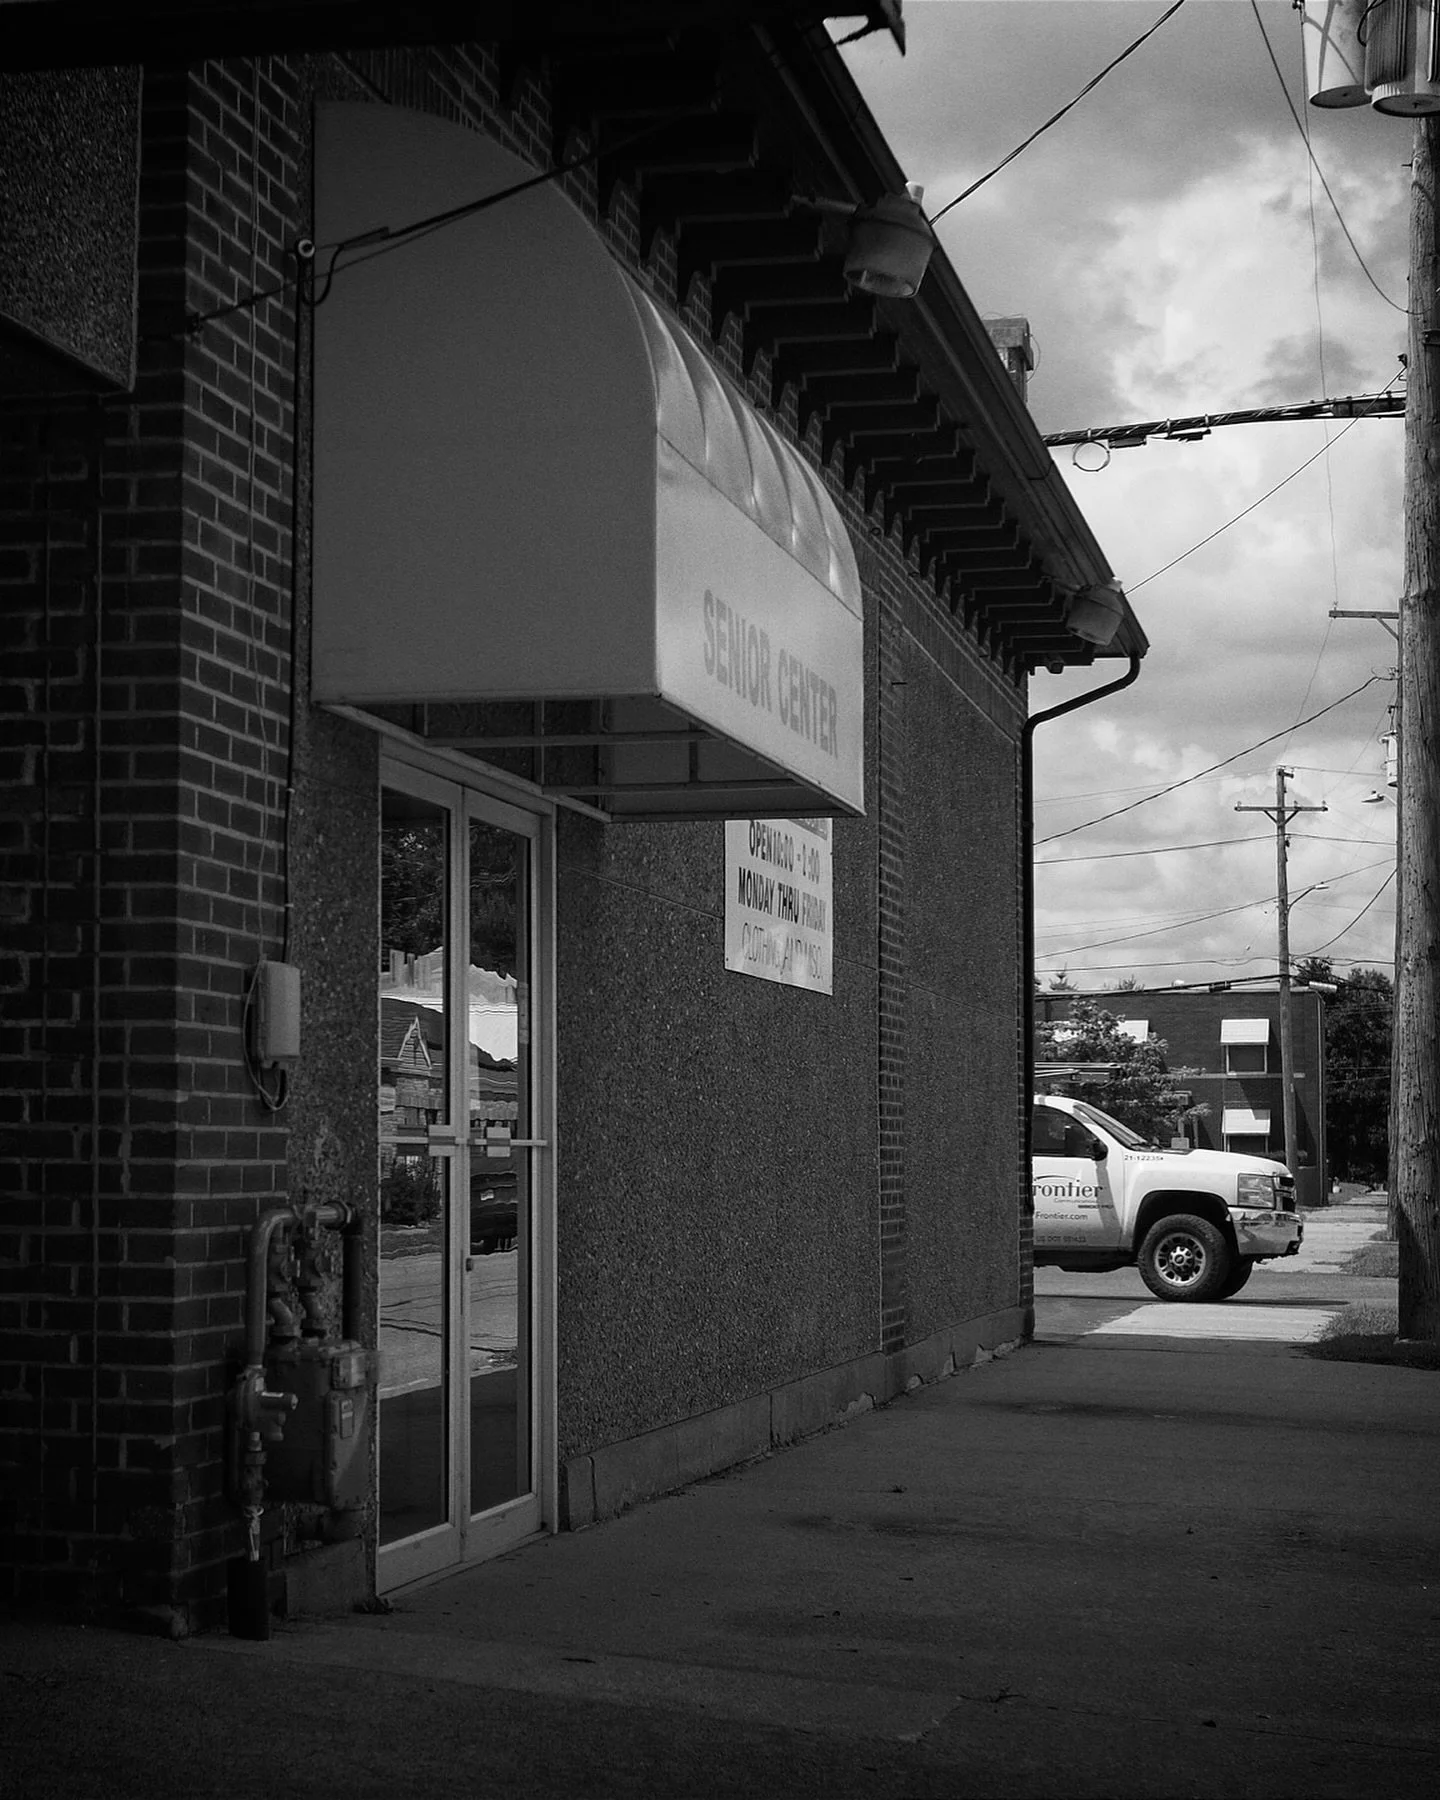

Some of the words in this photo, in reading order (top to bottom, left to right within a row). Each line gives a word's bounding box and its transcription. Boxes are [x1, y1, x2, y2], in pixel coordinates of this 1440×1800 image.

[703, 588, 772, 713] SENIOR
[778, 648, 838, 760] CENTER
[749, 820, 773, 863] OPEN
[738, 867, 775, 915] MONDAY
[777, 882, 800, 924] THRU
[1032, 1179, 1104, 1198] rontier
[1035, 1211, 1088, 1220] Frontier.com
